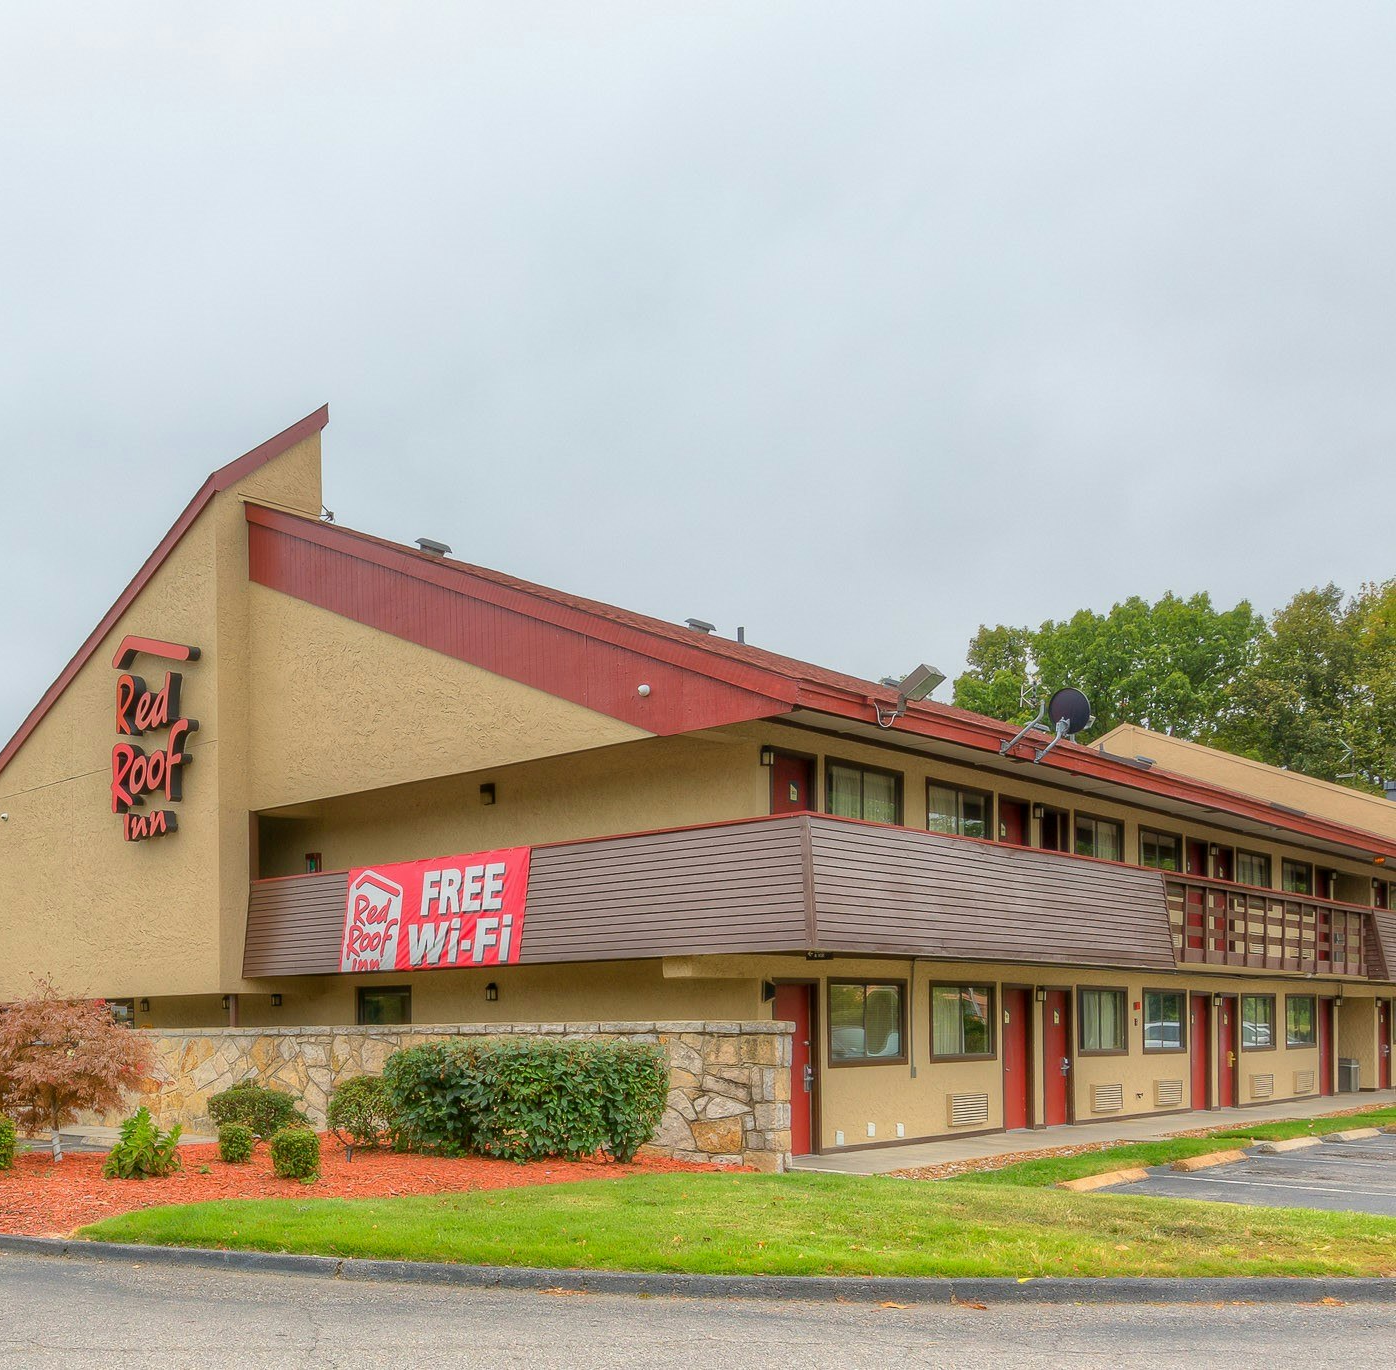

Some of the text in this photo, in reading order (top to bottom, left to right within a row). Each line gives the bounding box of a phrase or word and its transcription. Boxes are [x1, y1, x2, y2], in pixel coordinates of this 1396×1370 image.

[116, 671, 174, 734] Red
[111, 717, 192, 813] Roof
[355, 894, 392, 926] Red
[420, 862, 506, 917] FREE
[346, 917, 398, 960] Roof
[408, 914, 513, 966] Wi-Fi
